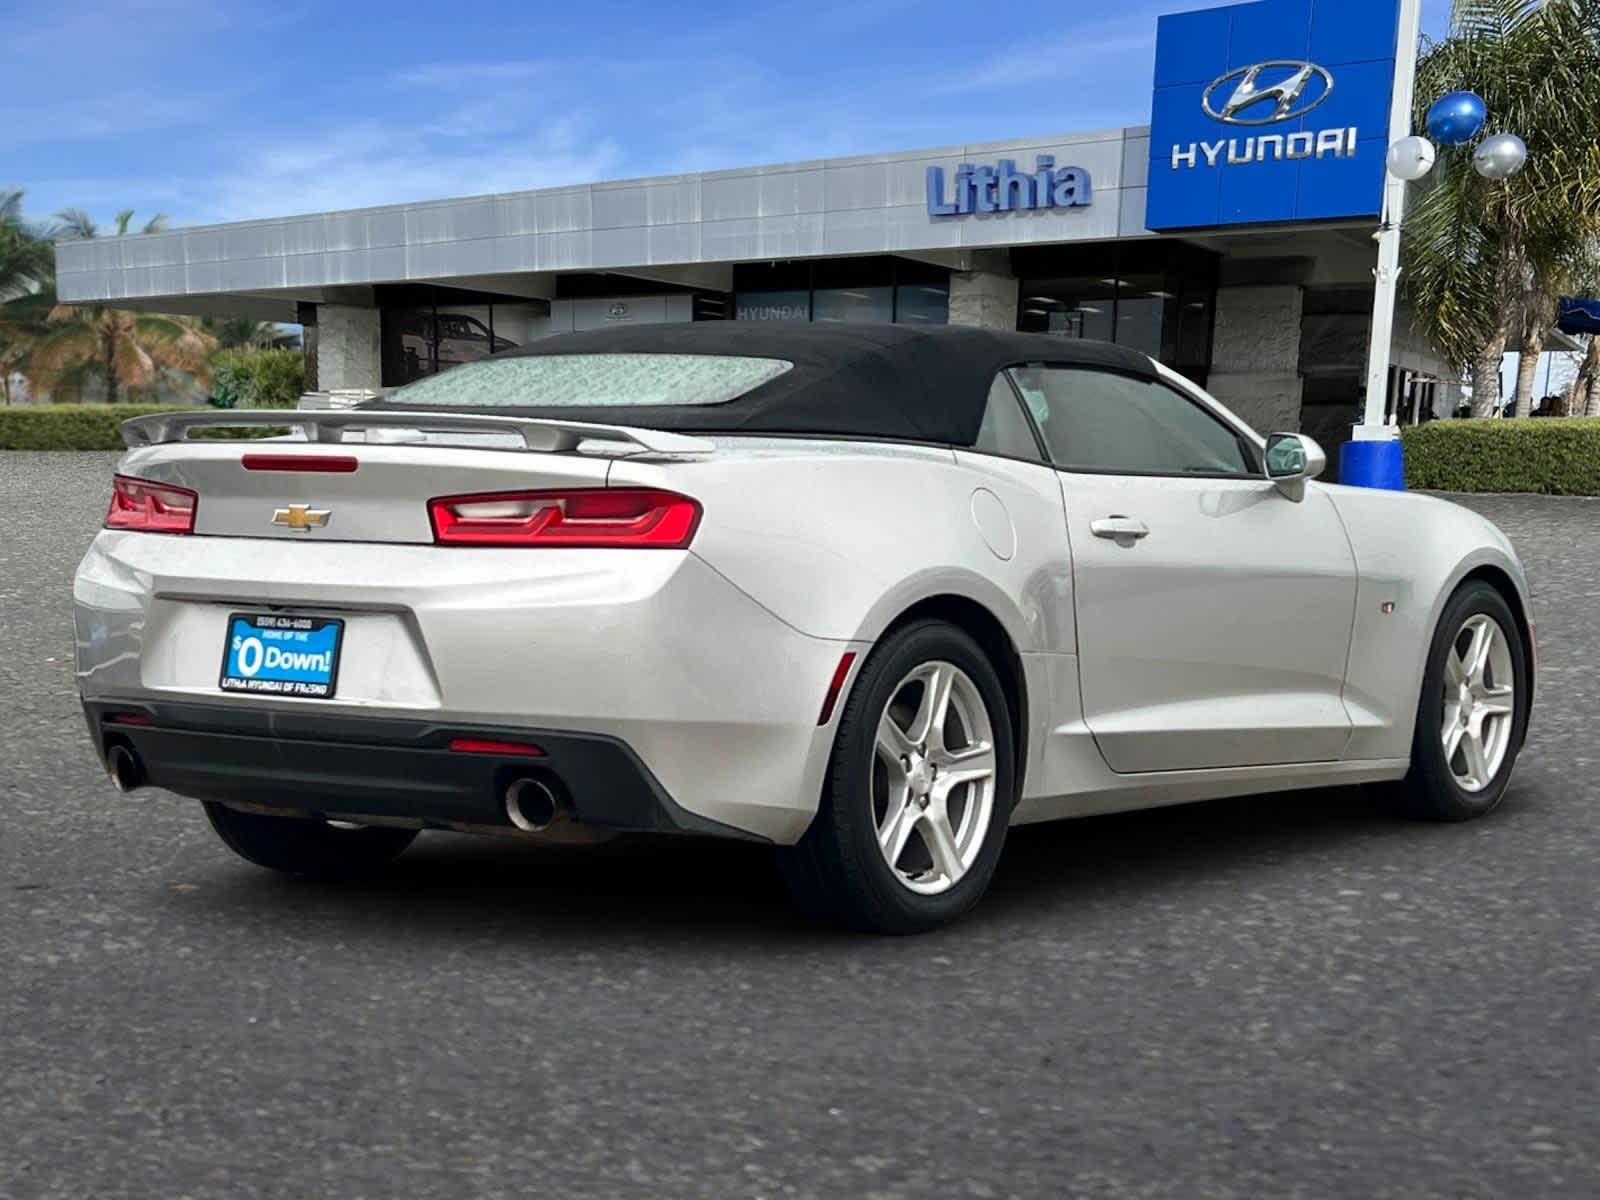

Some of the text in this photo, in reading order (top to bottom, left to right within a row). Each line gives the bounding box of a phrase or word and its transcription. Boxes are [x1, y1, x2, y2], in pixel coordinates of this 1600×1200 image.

[1171, 127, 1358, 169] HYUNDAI
[926, 155, 1093, 217] Lithia
[737, 305, 809, 320] HYUNDAI
[264, 646, 332, 672] Down!
